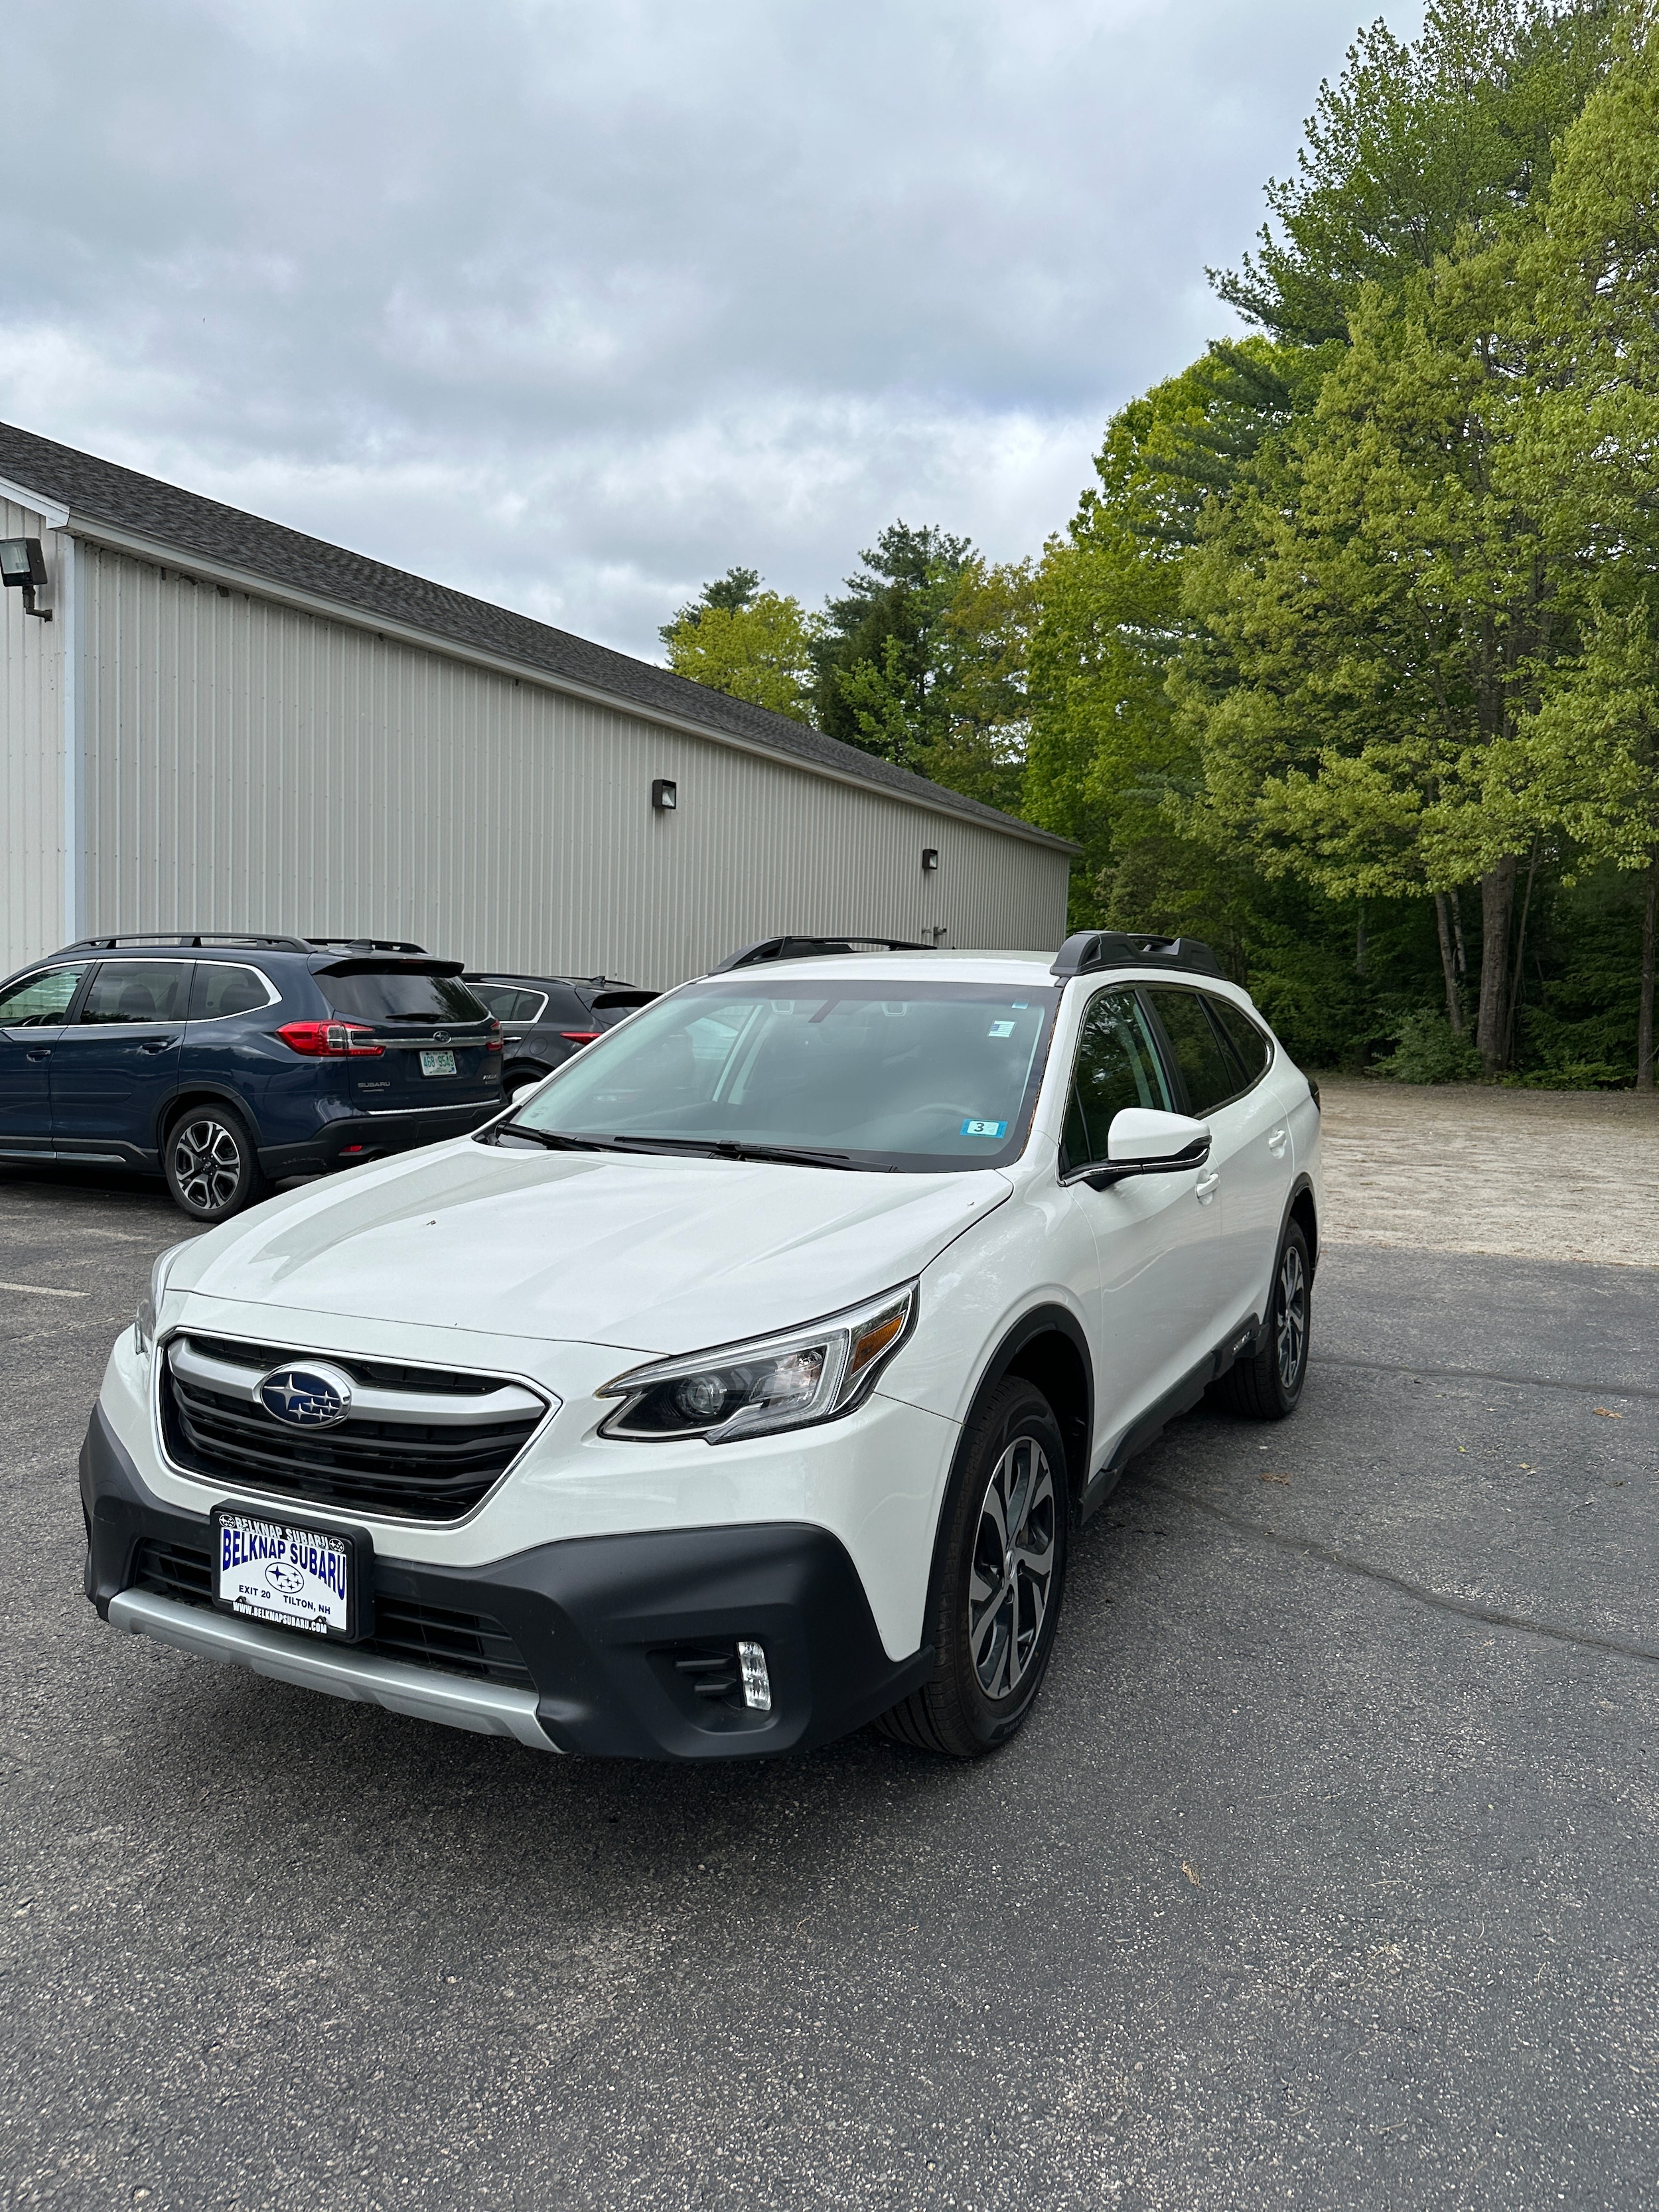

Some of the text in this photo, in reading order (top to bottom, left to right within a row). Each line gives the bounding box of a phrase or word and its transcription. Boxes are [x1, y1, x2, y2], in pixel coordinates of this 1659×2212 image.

[974, 1122, 985, 1132] 3
[235, 1516, 330, 1550] BELKNAP SUBARU
[222, 1528, 346, 1601] BELKNAP SUBARU
[239, 1584, 271, 1599] EXIT 20
[233, 1601, 327, 1634] WWW.BELKNAPSUBARU.COM
[283, 1595, 330, 1615] TILTON, NH
